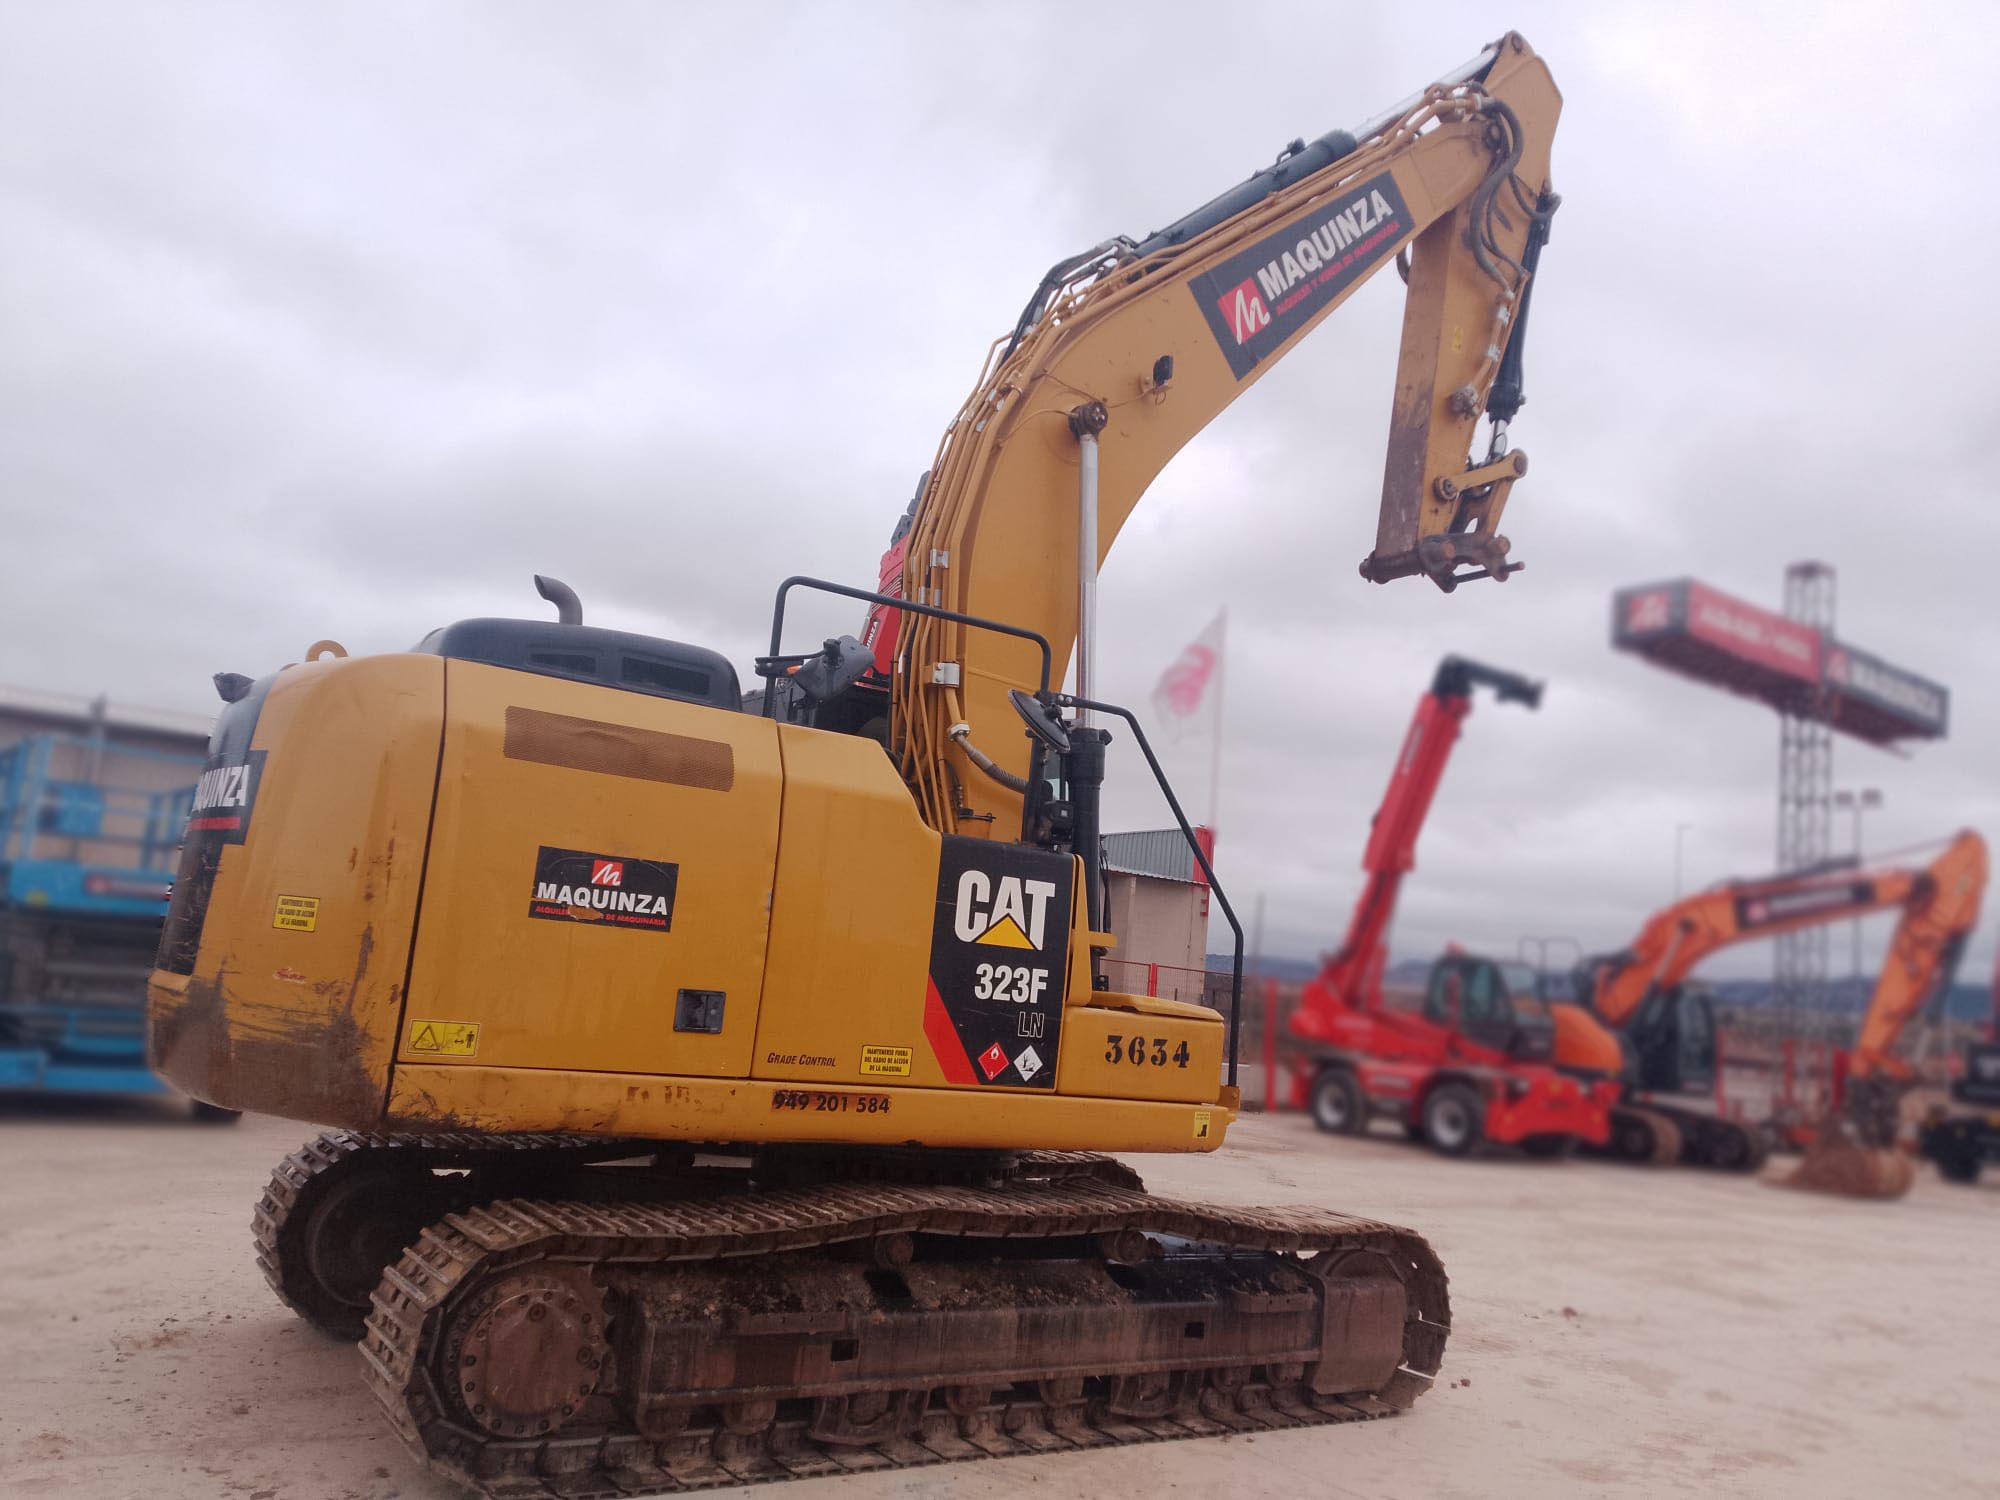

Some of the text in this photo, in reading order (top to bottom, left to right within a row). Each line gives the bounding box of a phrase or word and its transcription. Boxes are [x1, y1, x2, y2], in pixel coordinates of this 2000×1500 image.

[1256, 188, 1395, 301] MAQUINZA
[537, 881, 668, 916] MAQUINZA
[954, 870, 1056, 951] CAT
[974, 962, 1049, 1004] 323F
[1017, 1011, 1045, 1038] LN
[1105, 1034, 1190, 1068] 3634
[815, 1094, 848, 1112] 201
[856, 1096, 890, 1113] 584
